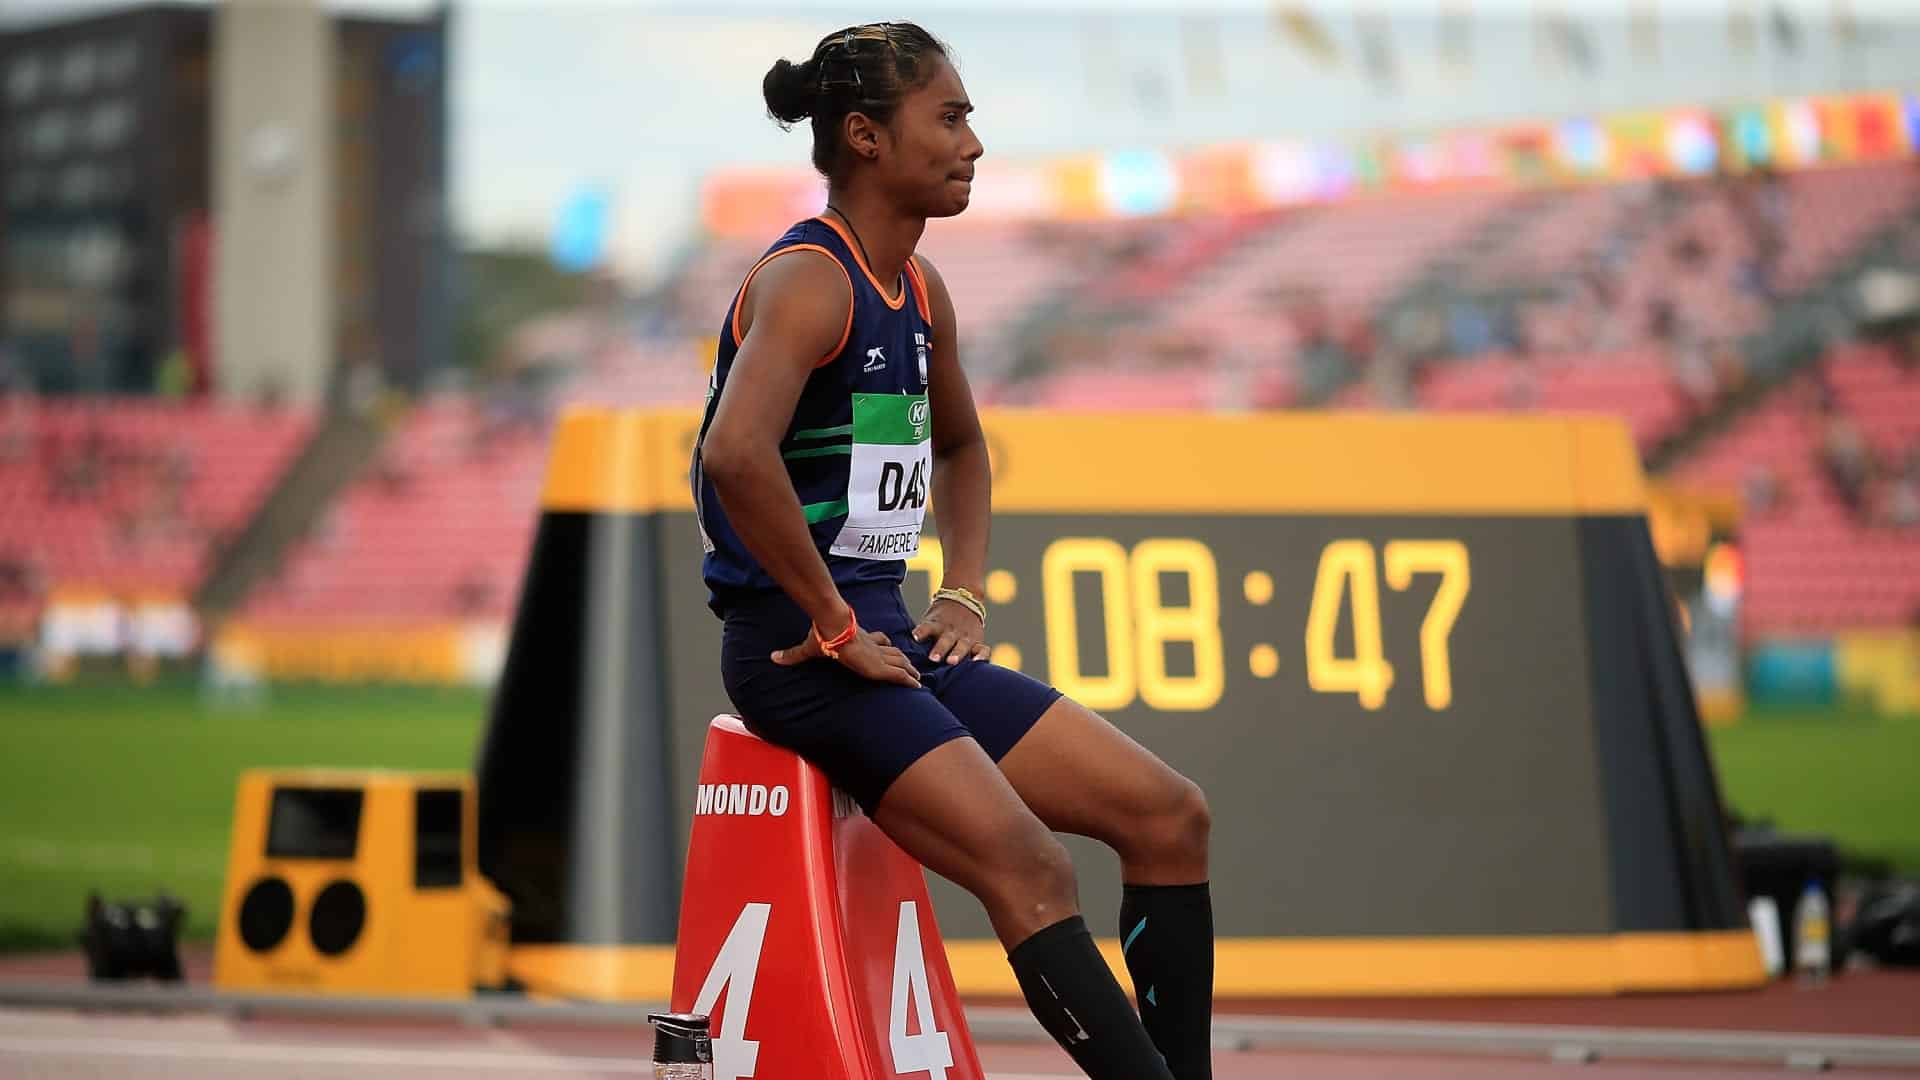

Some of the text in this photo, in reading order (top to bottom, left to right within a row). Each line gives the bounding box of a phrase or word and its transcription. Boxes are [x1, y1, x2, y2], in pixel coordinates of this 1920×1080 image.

[878, 457, 926, 511] DAS
[857, 532, 912, 554] TAMPERE
[695, 783, 789, 817] MONDO
[692, 902, 772, 1080] 4
[888, 900, 955, 1080] 4
